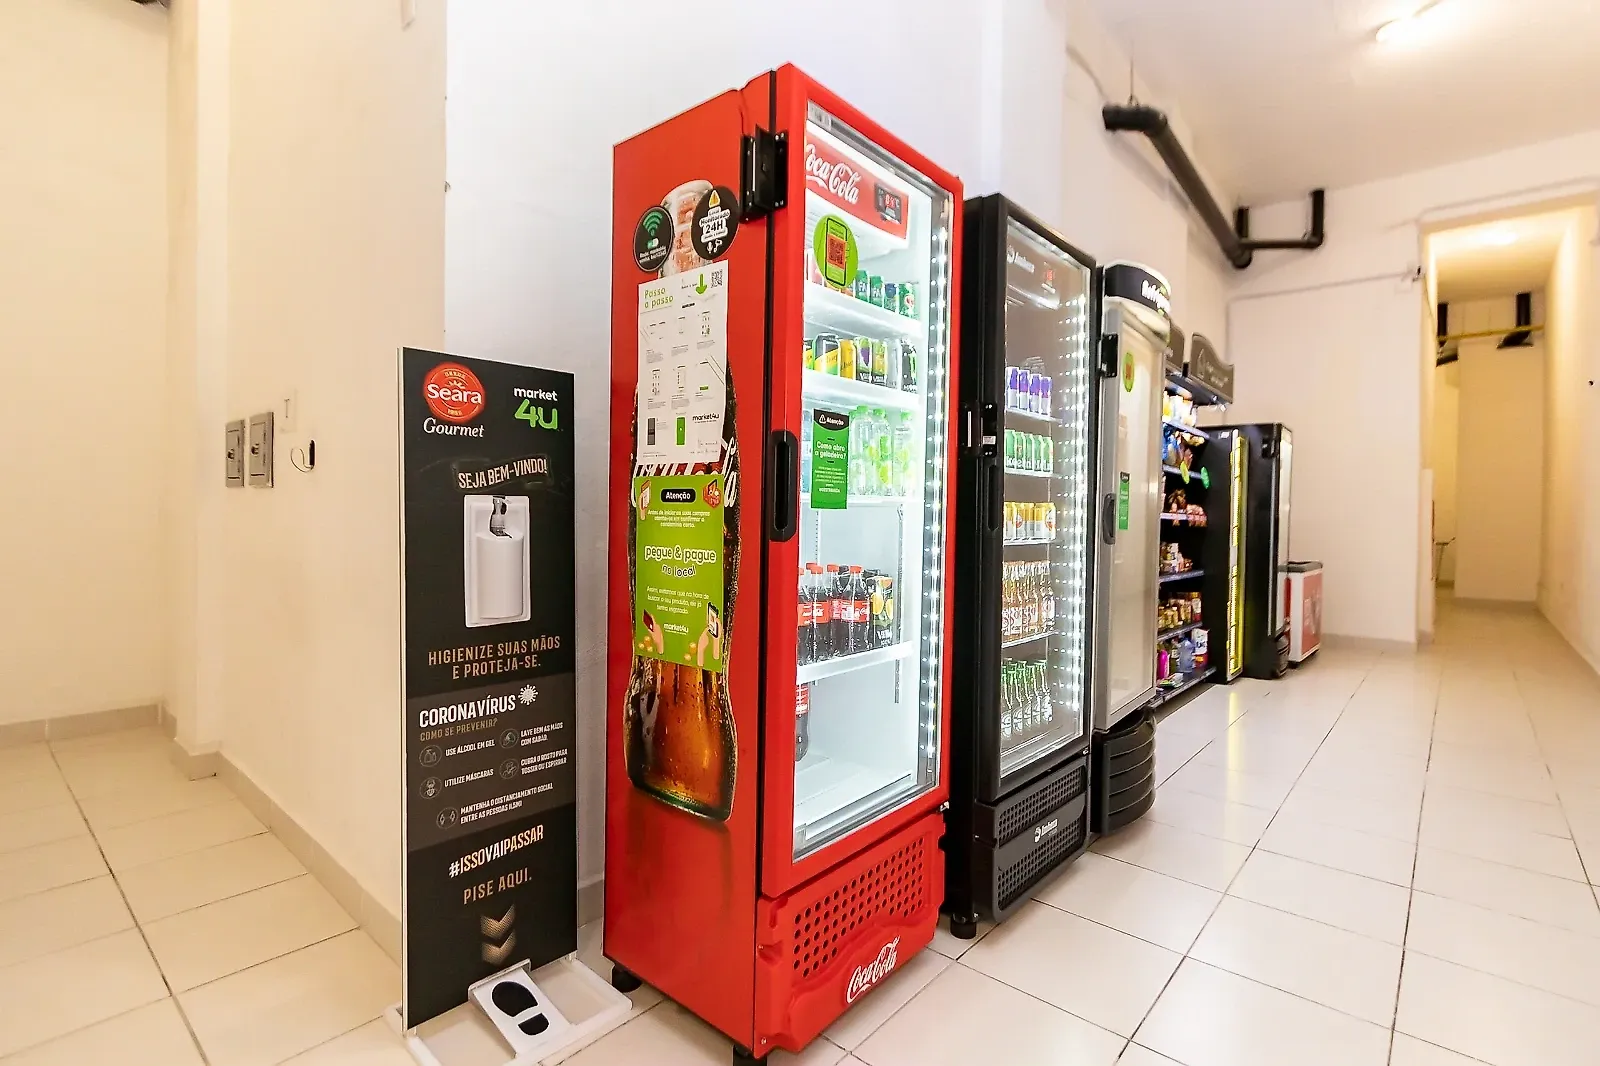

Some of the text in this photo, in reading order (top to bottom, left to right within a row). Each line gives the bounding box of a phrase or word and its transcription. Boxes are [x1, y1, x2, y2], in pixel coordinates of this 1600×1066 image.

[706, 220, 723, 234] 24H
[644, 287, 666, 299] Passo
[651, 296, 674, 308] passo
[428, 384, 482, 404] Seara
[513, 387, 558, 402] market
[692, 413, 720, 421] market4u
[424, 418, 485, 438] Gourmet
[458, 458, 548, 489] SEJA BEM-VINDO!
[666, 492, 691, 500] Atenção
[645, 544, 716, 565] pegue & pague
[674, 564, 696, 577] local
[428, 634, 561, 666] HIGIENIZE SUAS MÃOS
[452, 655, 541, 679] E PROTEJA-SE.
[419, 694, 516, 728] CORONAVÍRUS
[420, 718, 498, 742] COMO SE PREVENIR?
[446, 747, 456, 756] USE
[456, 742, 476, 755] ÁLCOOL
[477, 741, 485, 750] EM
[444, 768, 494, 787] UTILIZE MÁSCARAS
[460, 800, 490, 814] MANTENHA
[495, 786, 537, 805] DISTANCIAMENTO
[460, 814, 478, 824] ENTRE
[478, 811, 486, 819] AS
[486, 804, 509, 817] PESSOAS
[449, 824, 544, 878] #ISSOVAIPASSAR
[463, 867, 532, 904] PISE AQUI.
[846, 935, 901, 1004] Coca-Cola
